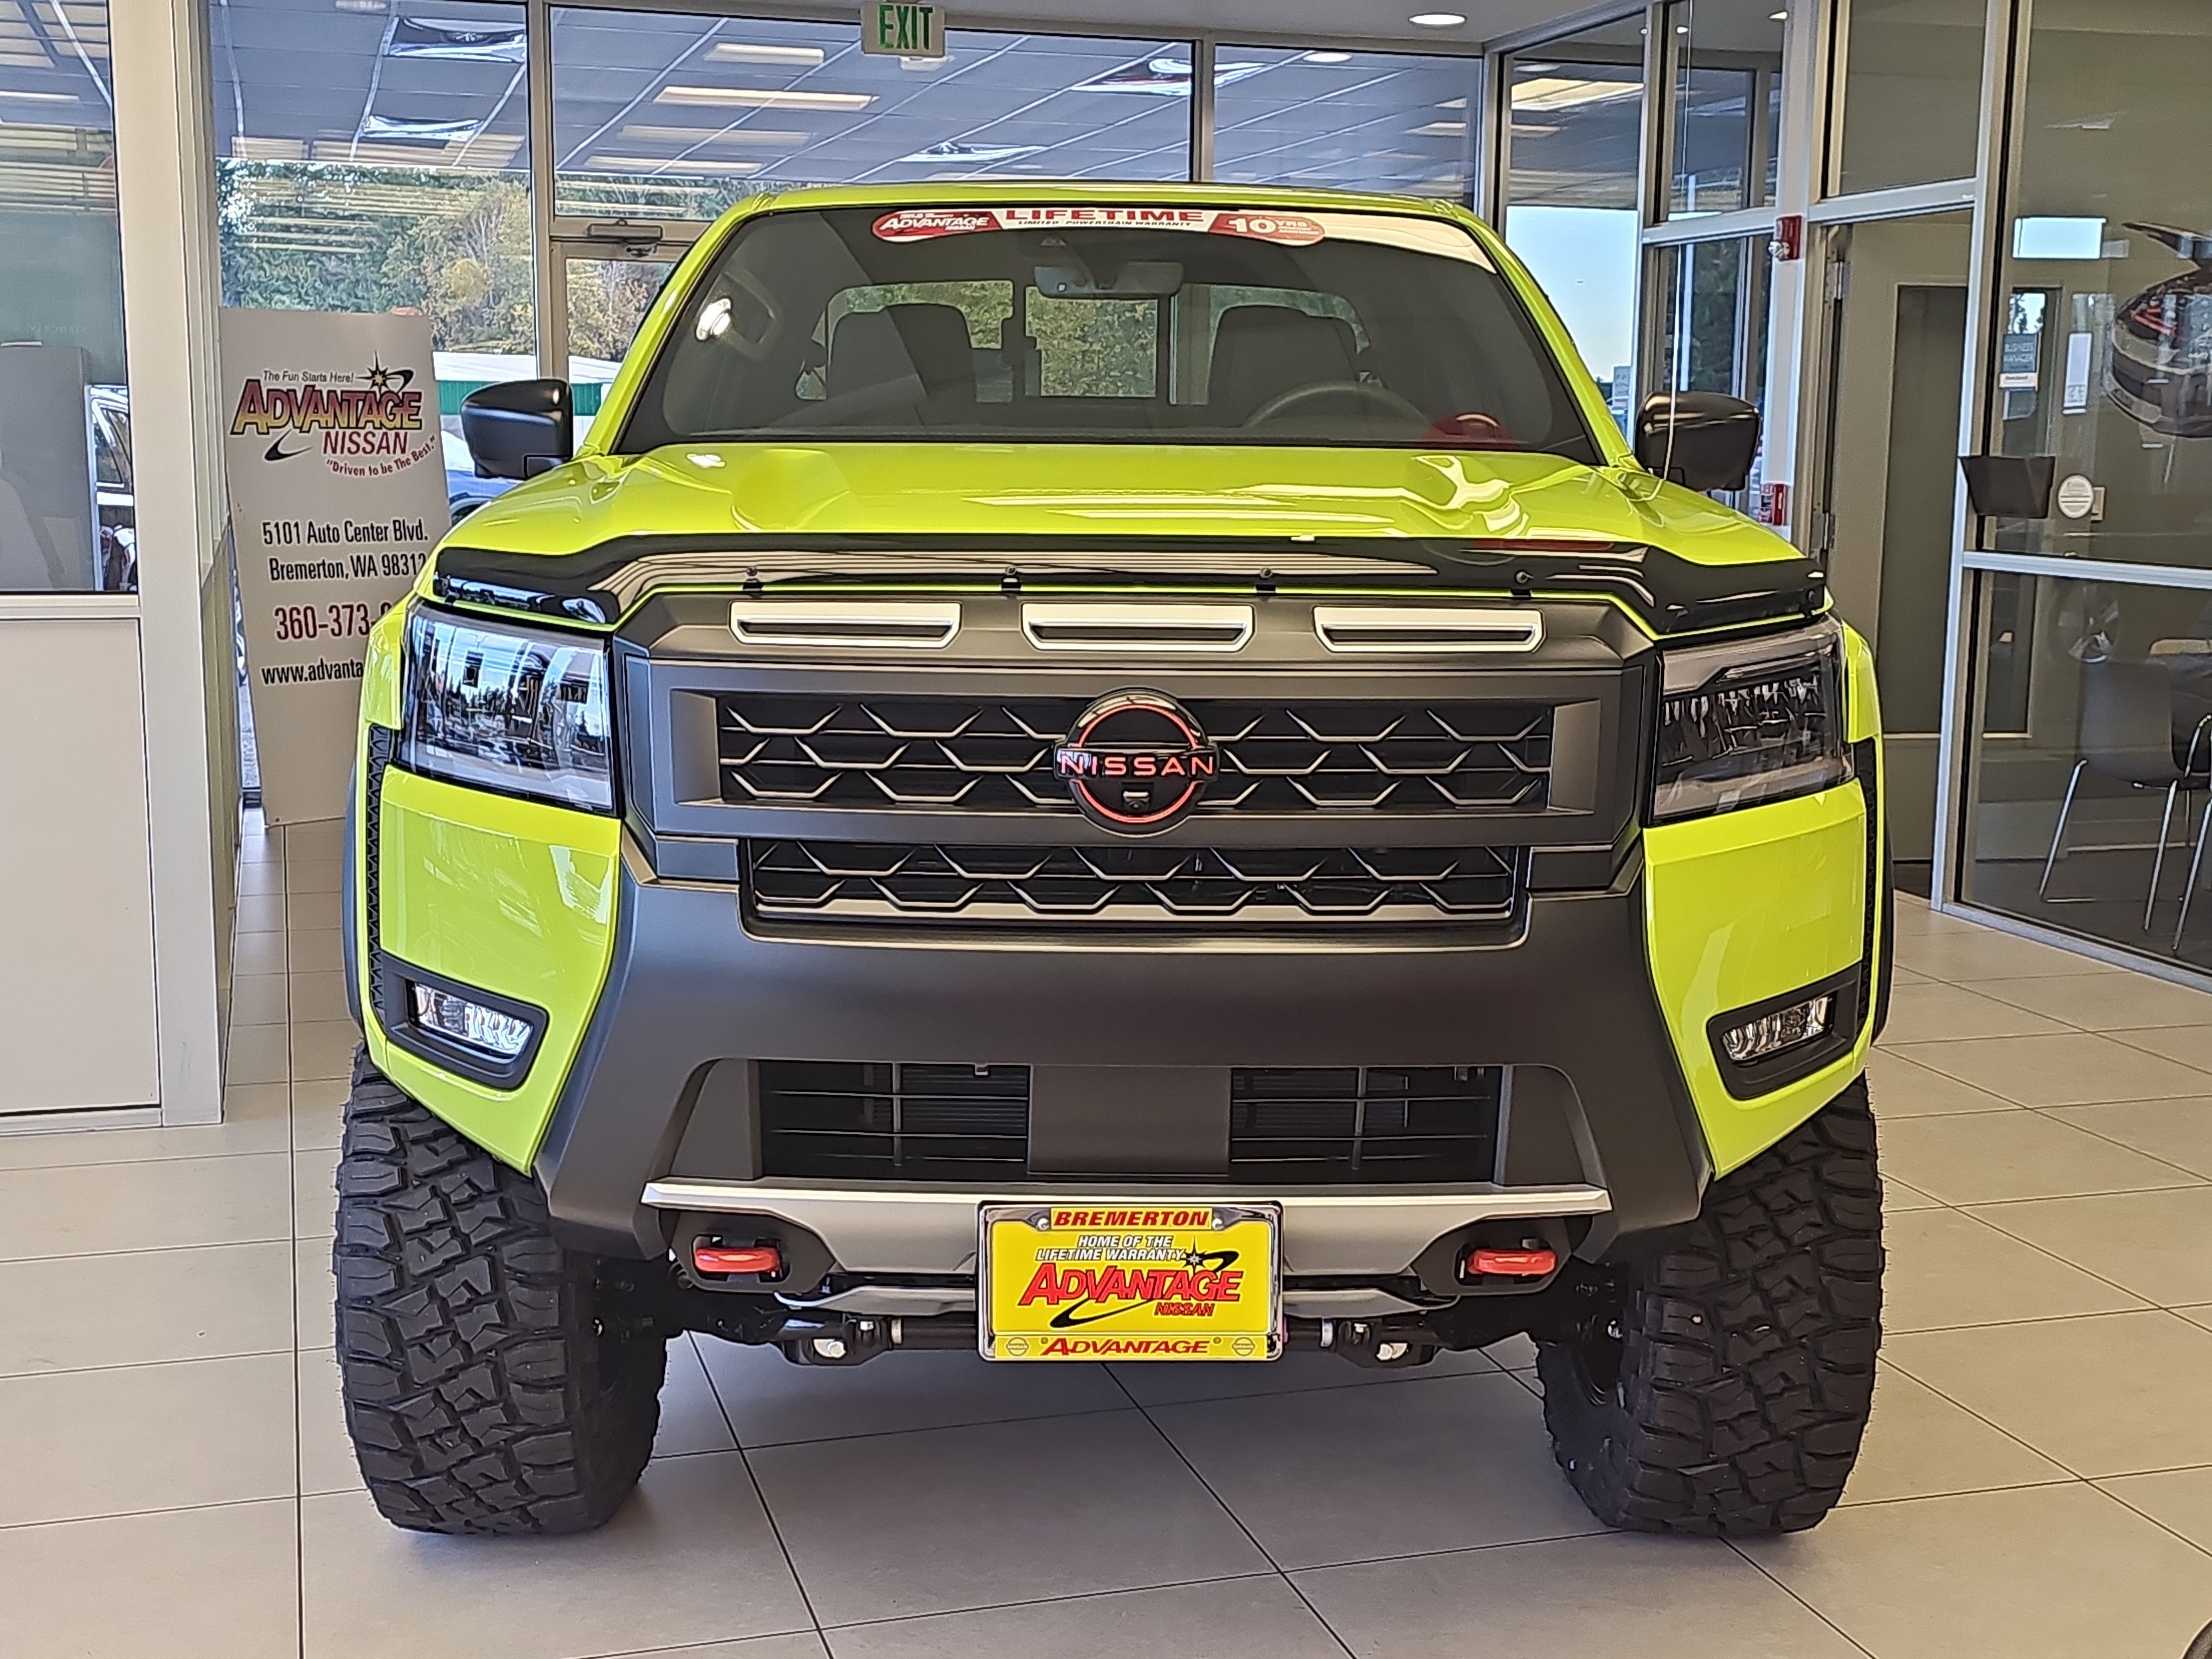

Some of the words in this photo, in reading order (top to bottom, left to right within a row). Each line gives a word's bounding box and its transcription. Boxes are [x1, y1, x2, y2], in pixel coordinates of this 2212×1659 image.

[879, 4, 933, 50] EXIT
[879, 216, 989, 230] ADVANTAGE
[1005, 210, 1204, 222] LIFETIME
[1229, 218, 1276, 233] 10
[263, 370, 280, 382] The
[282, 370, 299, 382] Fun
[301, 371, 327, 382] Starts
[329, 371, 354, 383] Here!
[230, 379, 422, 435] ADVANTAGE
[323, 430, 408, 455] NISSAN
[326, 459, 365, 476] "Driven
[369, 466, 379, 476] to
[380, 462, 394, 474] be
[394, 457, 411, 471] The
[411, 435, 435, 462] Best."
[262, 521, 301, 545] 5101
[307, 520, 340, 544] Auto
[344, 520, 389, 543] Center
[392, 518, 428, 542] Blvd.
[269, 557, 349, 581] Bremerton,
[350, 554, 378, 578] WA
[381, 552, 427, 576] 98312
[261, 658, 363, 685] www.advanta
[1060, 756, 1213, 775] NISSAN
[1053, 1211, 1210, 1226] BREMERTON
[1077, 1234, 1120, 1248] HOME
[1123, 1234, 1143, 1248] OF
[1146, 1234, 1174, 1248] THE
[1036, 1248, 1104, 1261] LIFETIME
[1106, 1248, 1185, 1261] WARRANTY
[1018, 1263, 1244, 1306] ADVANTAGE
[1154, 1302, 1215, 1317] NISSAN
[1040, 1338, 1210, 1356] ADVANTAGE
